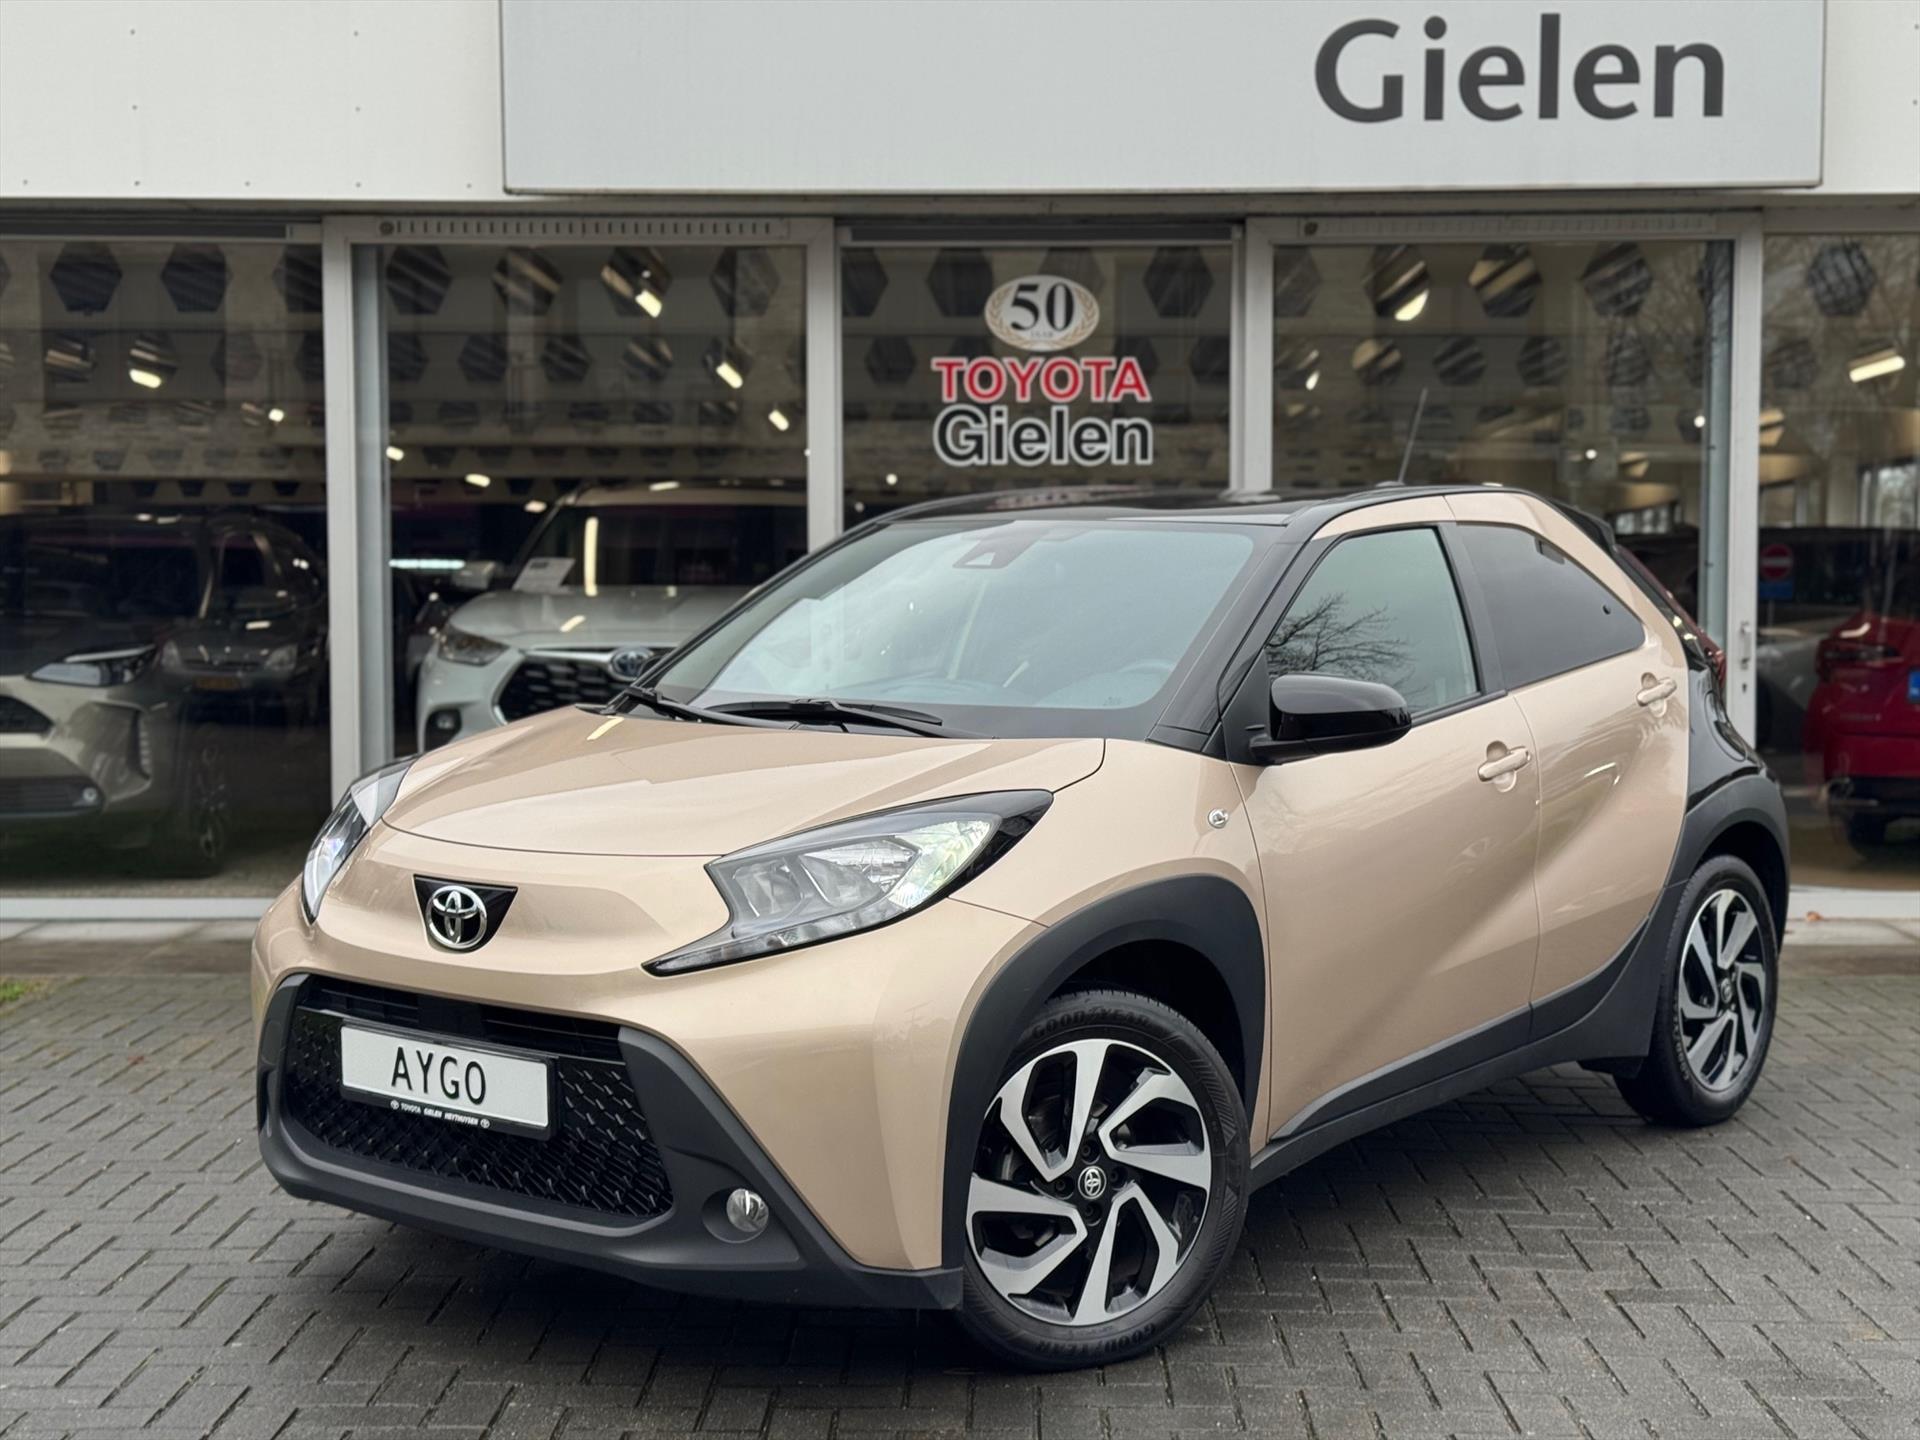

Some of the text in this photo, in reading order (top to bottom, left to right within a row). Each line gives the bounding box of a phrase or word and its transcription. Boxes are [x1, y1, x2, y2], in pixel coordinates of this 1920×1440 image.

[1315, 13, 1725, 123] Gielen
[1010, 281, 1075, 332] 50
[931, 357, 1152, 402] TOYOTA
[932, 403, 1153, 467] Gielen
[391, 1046, 486, 1105] AYGO
[401, 1103, 422, 1114] TOYOTA
